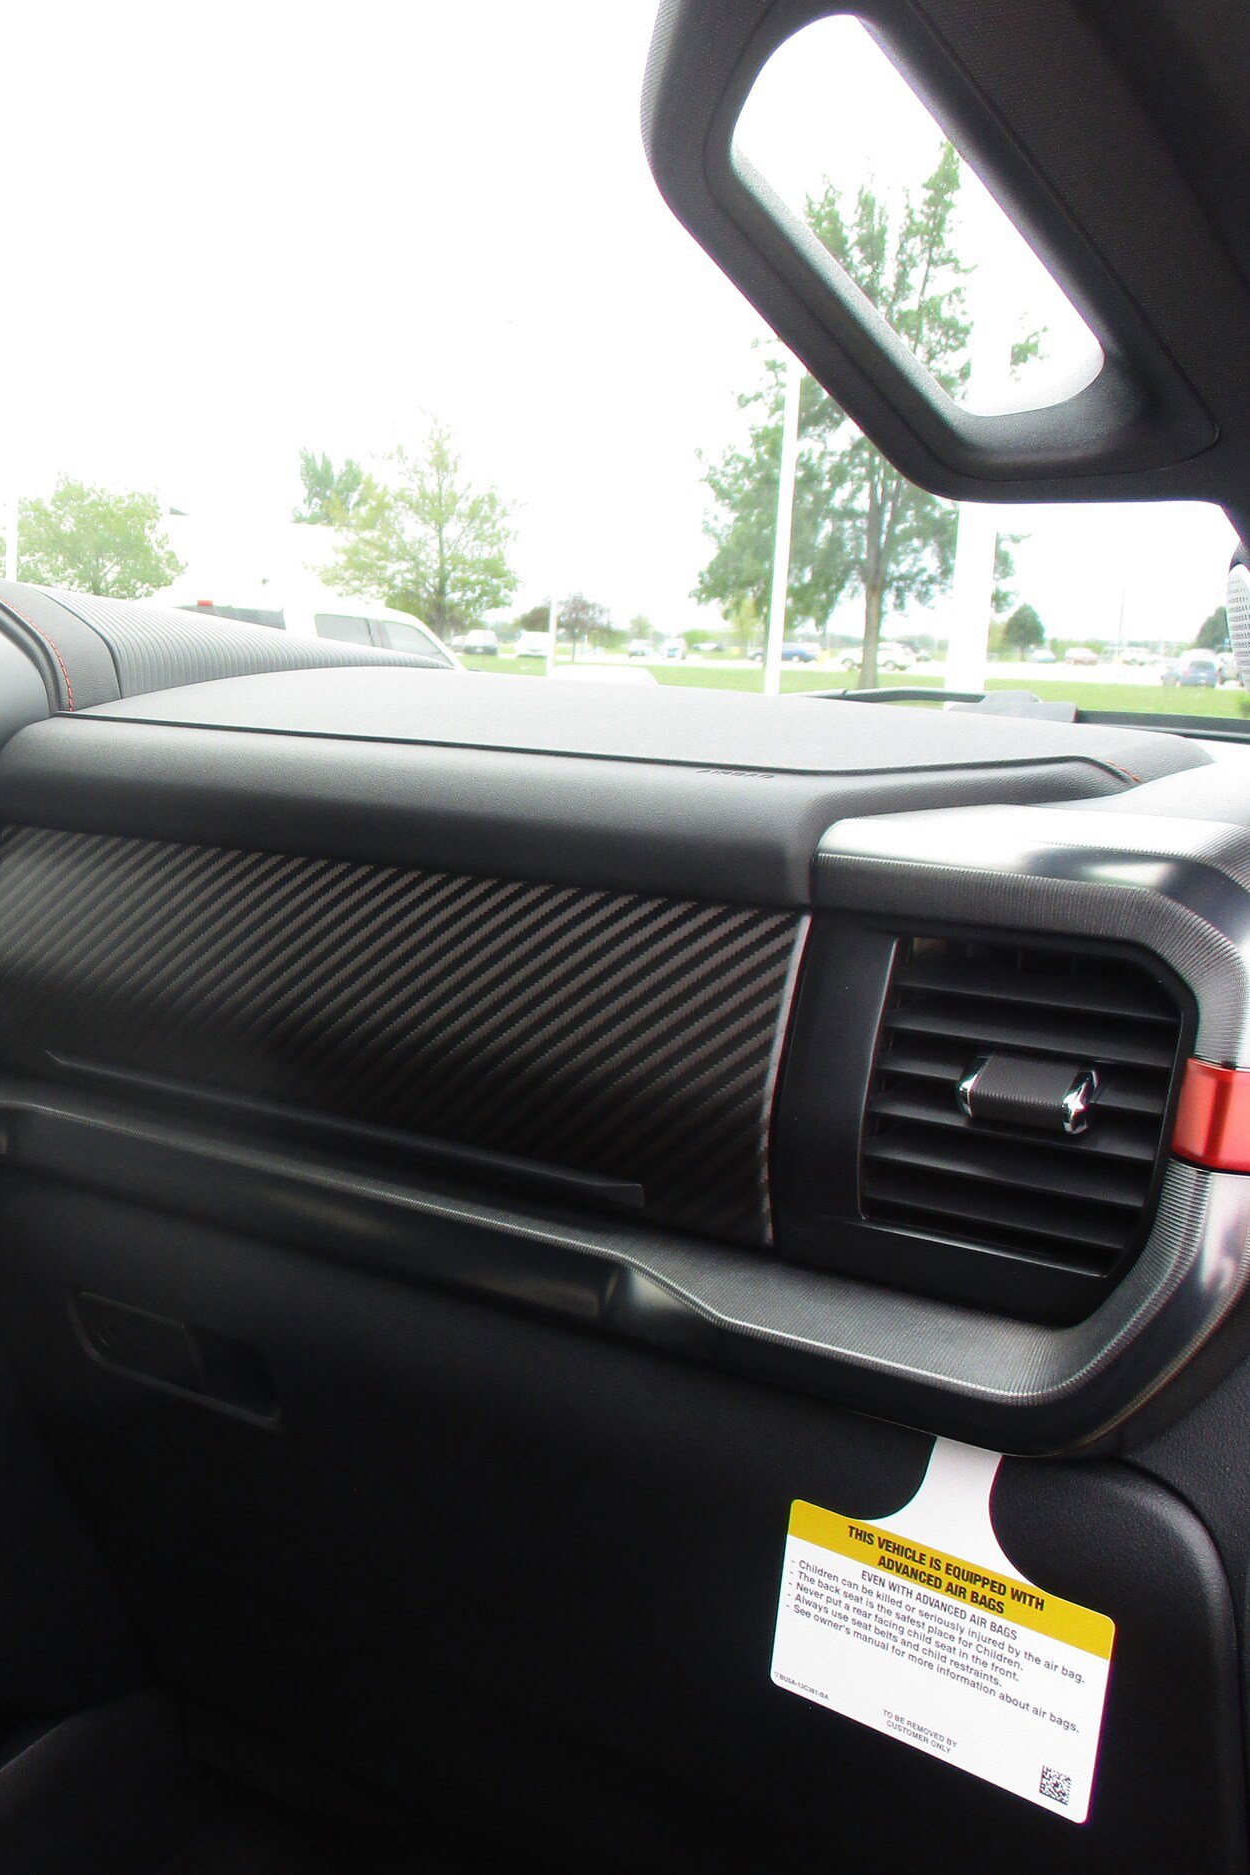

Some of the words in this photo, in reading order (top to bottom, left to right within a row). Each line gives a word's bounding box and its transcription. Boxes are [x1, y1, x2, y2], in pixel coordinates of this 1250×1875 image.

[848, 1525, 875, 1546] THIS
[877, 1536, 927, 1566] VEHICLE
[929, 1556, 942, 1572] IS
[944, 1562, 1007, 1596] EQUIPPED
[1010, 1587, 1045, 1612] WITH
[861, 1570, 886, 1588] EVEN
[888, 1580, 913, 1599] WITH
[915, 1592, 967, 1620] ADVANCED
[969, 1613, 987, 1629] AIR
[989, 1621, 1017, 1641] BAGS
[877, 1555, 943, 1590] ADVANCED
[945, 1581, 967, 1601] AIR
[969, 1590, 1005, 1614] BAGS
[794, 1593, 829, 1614] Always
[831, 1609, 849, 1622] use
[851, 1618, 872, 1632] seat
[874, 1625, 898, 1643] belts
[900, 1638, 920, 1652] and
[921, 1647, 947, 1664] child
[949, 1659, 1002, 1687] restraints.
[796, 1581, 824, 1600] Never
[825, 1595, 842, 1608] put
[852, 1606, 873, 1619] rear
[874, 1614, 905, 1636] facing
[907, 1629, 932, 1645] child
[934, 1640, 957, 1655] seat
[958, 1648, 969, 1660] in
[971, 1654, 988, 1668] the
[991, 1662, 1019, 1682] front.
[798, 1570, 816, 1585] The
[817, 1578, 841, 1595] back
[843, 1590, 864, 1604] seat
[865, 1598, 874, 1609] is
[877, 1603, 893, 1616] the
[895, 1612, 926, 1630] safest
[927, 1625, 956, 1642] place
[958, 1636, 973, 1649] for
[975, 1643, 1023, 1671] Children.
[798, 1559, 839, 1583] Children
[841, 1578, 859, 1591] can
[861, 1584, 874, 1599] be
[876, 1590, 903, 1609] killed
[904, 1604, 916, 1616] or
[918, 1609, 965, 1635] seriously
[968, 1627, 1005, 1650] injured
[1007, 1644, 1021, 1658] by
[1024, 1651, 1041, 1665] the
[1043, 1660, 1059, 1672] air
[1061, 1665, 1085, 1684] bag.
[793, 1604, 811, 1619] See
[813, 1614, 851, 1635] owner's
[853, 1630, 889, 1651] manual
[891, 1645, 906, 1658] for
[908, 1653, 934, 1670] more
[936, 1664, 996, 1697] information
[998, 1692, 1030, 1711] about
[1032, 1707, 1047, 1718] air
[1049, 1712, 1079, 1733] bags.
[883, 1708, 894, 1719] TO
[894, 1714, 906, 1725] BE
[906, 1719, 945, 1742] REMOVED
[946, 1737, 958, 1748] BY
[886, 1719, 929, 1744] CUSTOMER
[930, 1739, 951, 1754] ONLY
